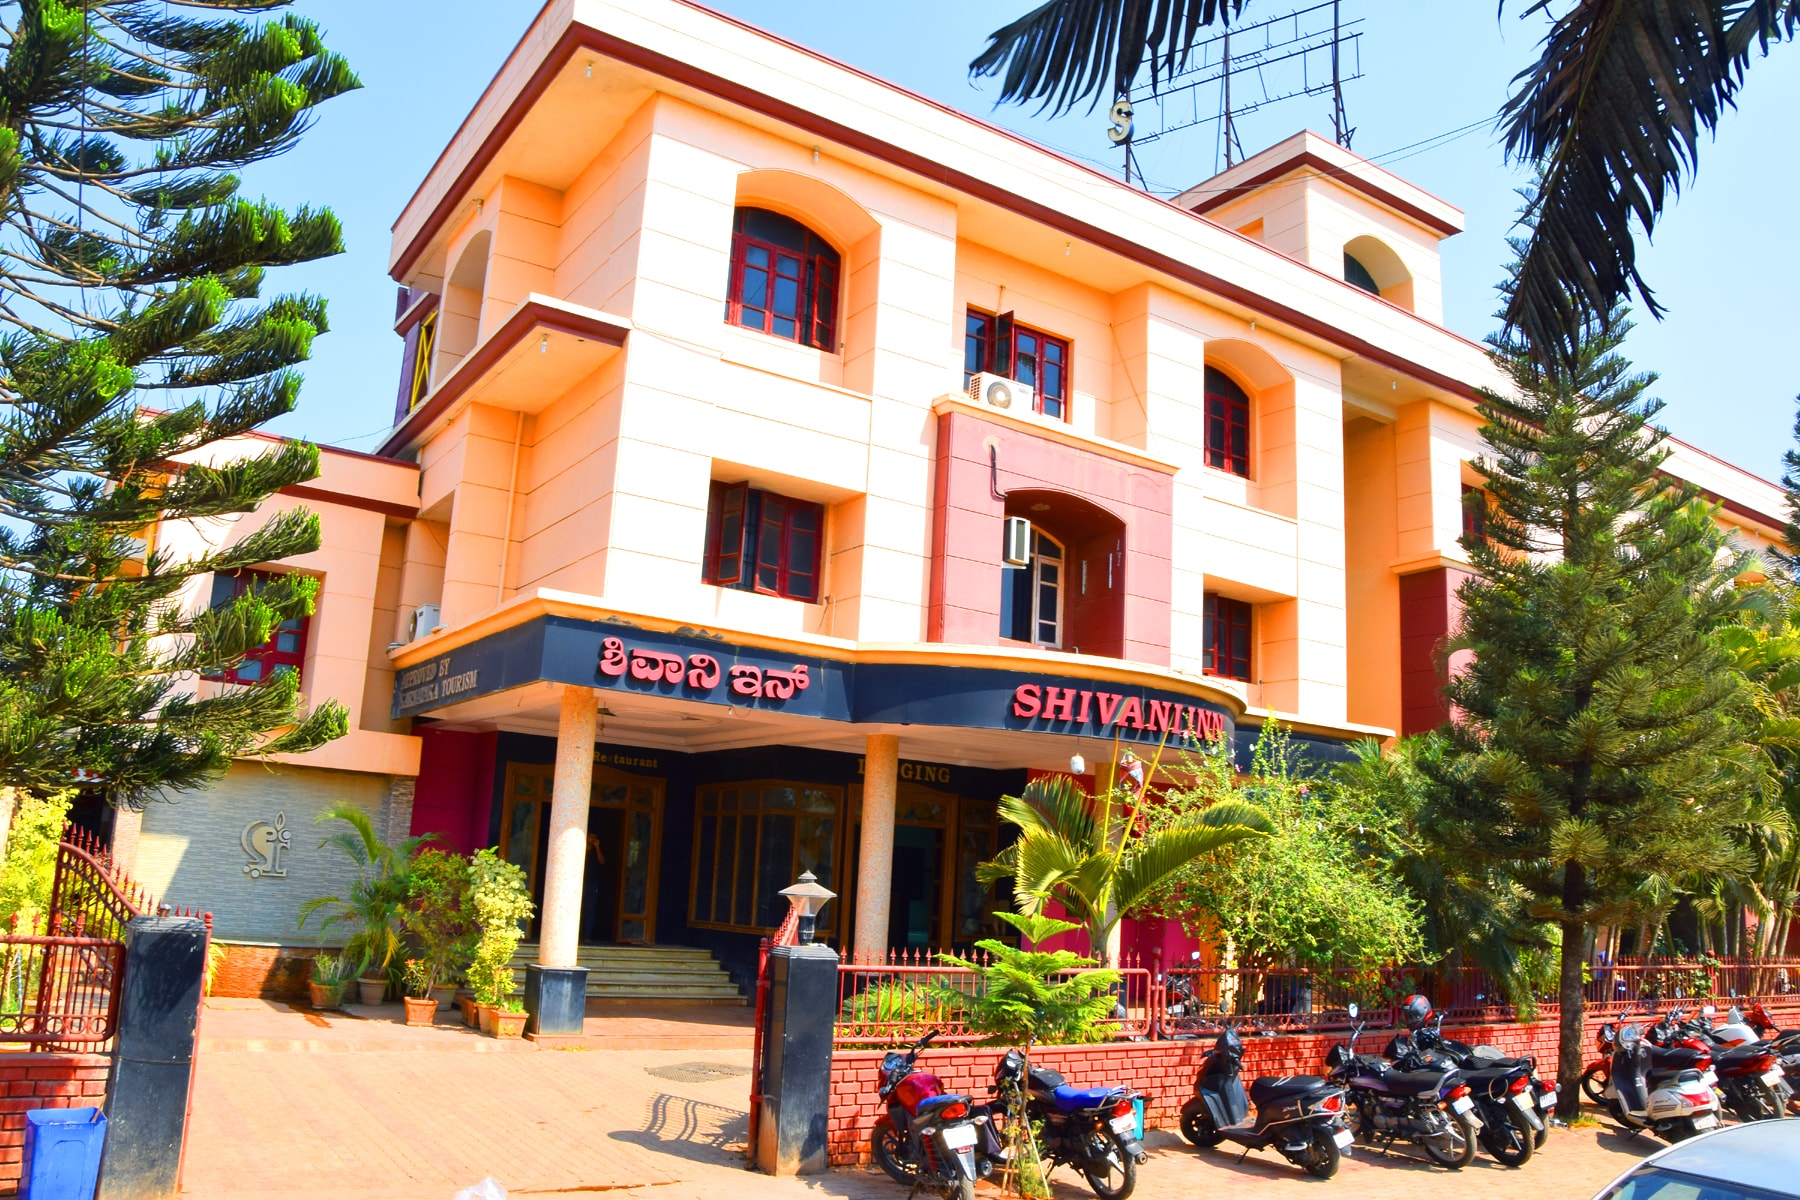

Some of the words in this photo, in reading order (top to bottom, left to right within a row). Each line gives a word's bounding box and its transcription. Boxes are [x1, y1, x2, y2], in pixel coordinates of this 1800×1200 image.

[438, 657, 451, 677] BY
[600, 636, 721, 689] ಶಿವಾನಿ
[730, 664, 810, 699] ಇನ್
[441, 669, 478, 697] TOURISM
[1013, 683, 1183, 735] SHIVANI
[1186, 706, 1225, 742] INN
[857, 758, 951, 783] LGING
